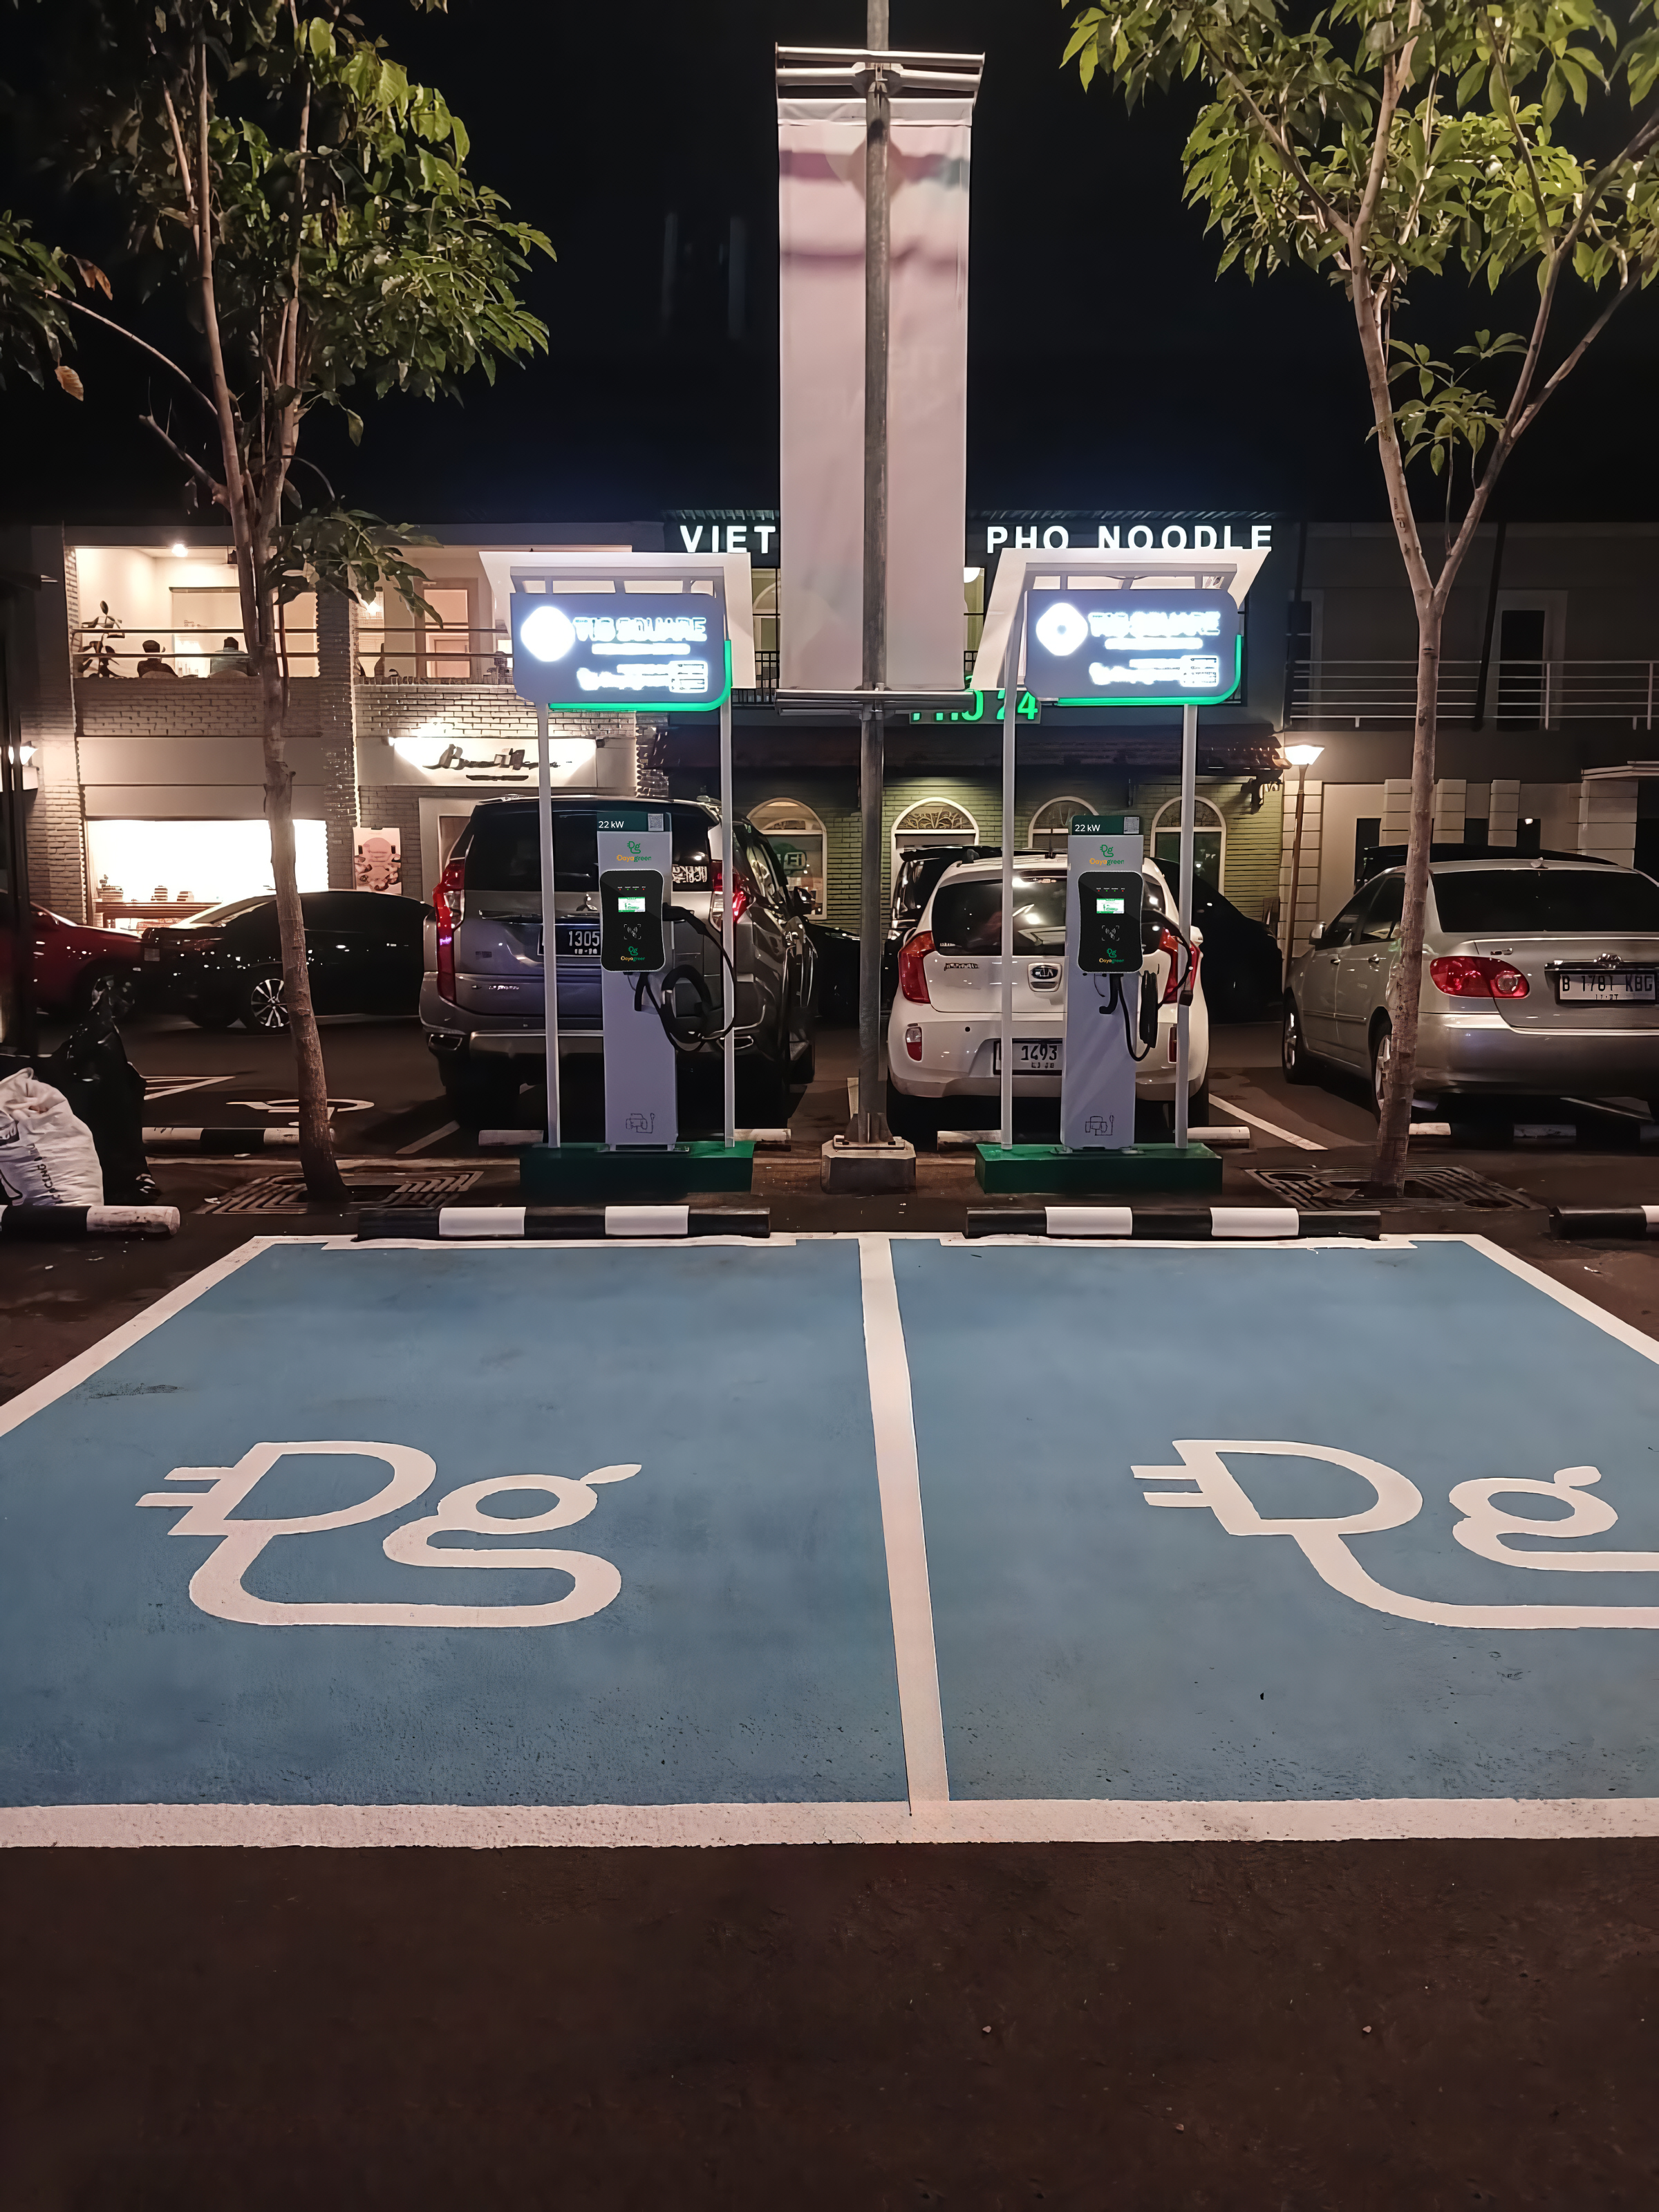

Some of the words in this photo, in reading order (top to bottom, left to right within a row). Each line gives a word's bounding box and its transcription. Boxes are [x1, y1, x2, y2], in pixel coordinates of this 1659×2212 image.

[680, 525, 776, 554] VIET
[986, 526, 1069, 553] PHO
[1098, 525, 1272, 551] NOODLE
[568, 930, 601, 946] 1305
[1562, 975, 1570, 992] B
